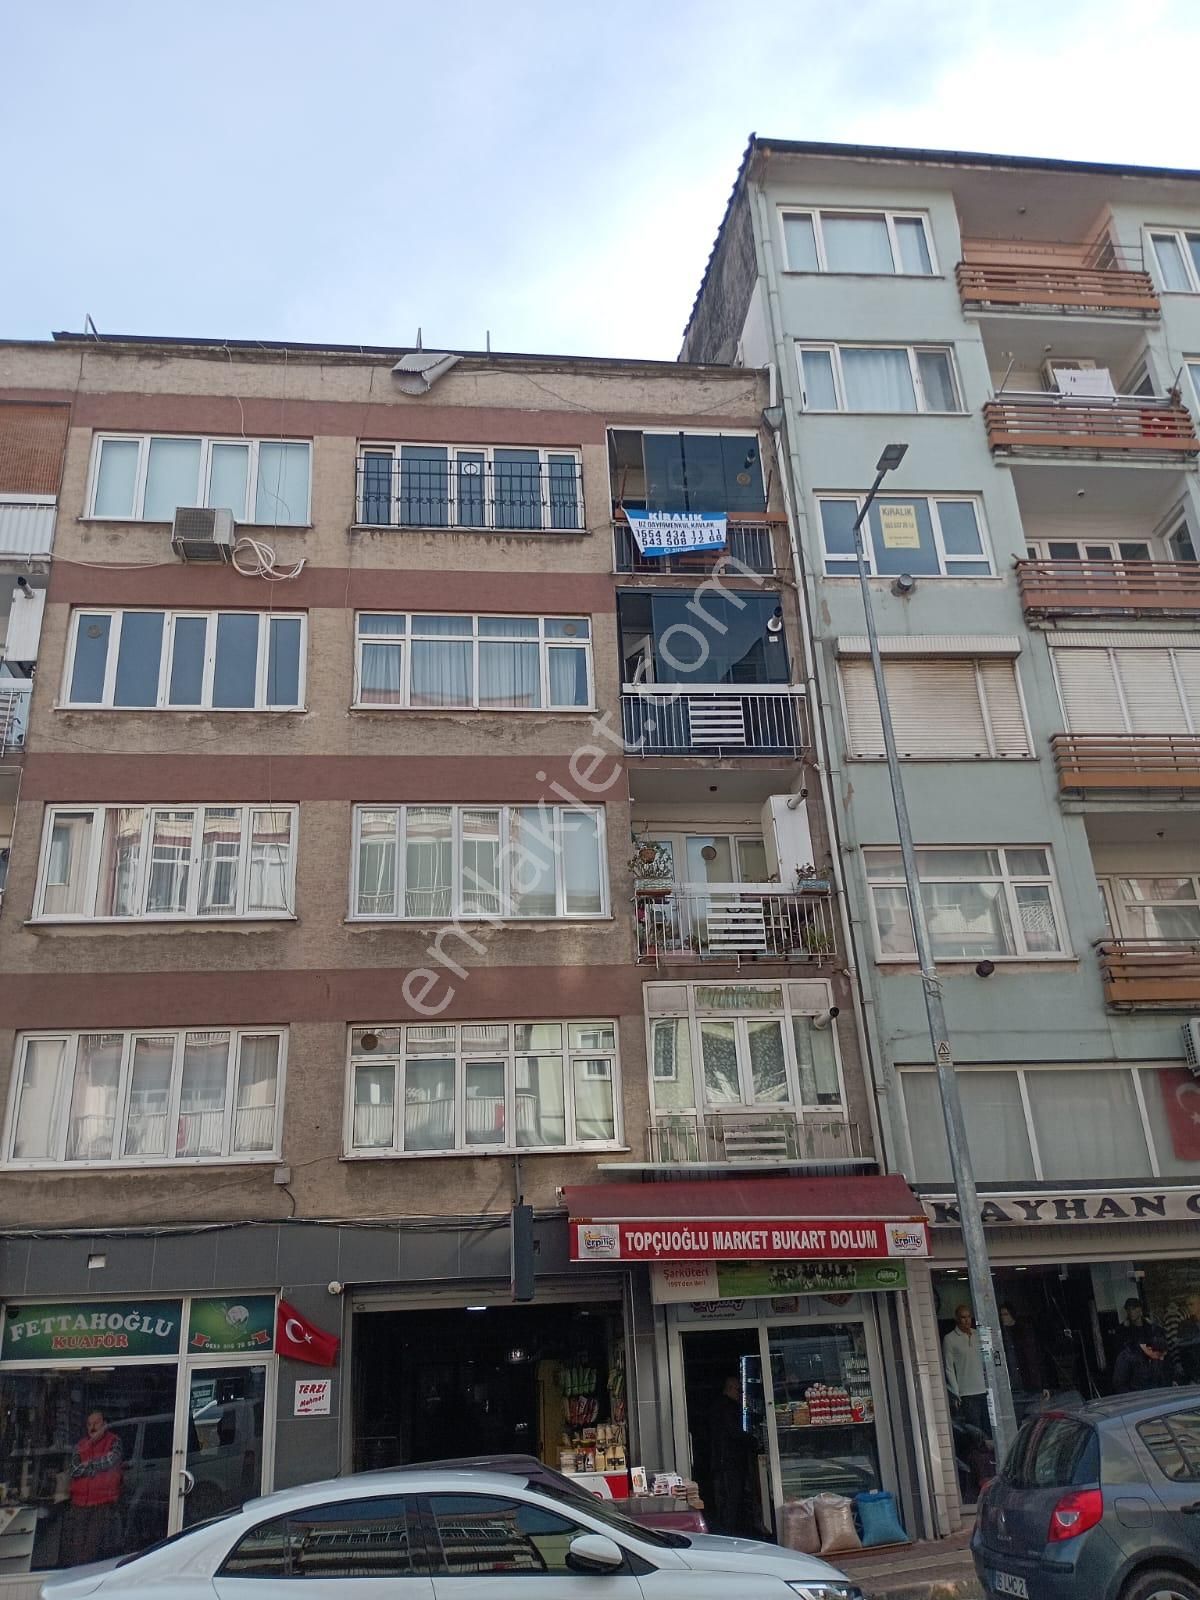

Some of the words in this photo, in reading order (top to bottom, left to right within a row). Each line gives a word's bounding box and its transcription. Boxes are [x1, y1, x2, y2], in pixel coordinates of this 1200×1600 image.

[648, 510, 702, 521] KİRALIK
[665, 530, 686, 539] 434
[692, 530, 703, 538] 11
[709, 528, 721, 537] 11
[931, 1195, 1166, 1224] KAYHAN
[625, 1228, 709, 1255] TOPÇUOĞLU
[712, 1230, 768, 1250] MARKET
[771, 1230, 827, 1250] BUKART
[830, 1230, 878, 1249] DOLUM
[10, 1310, 174, 1342] FETTAHOĞLU
[53, 1332, 128, 1349] KUAFÖR
[298, 1381, 327, 1394] TERZİ
